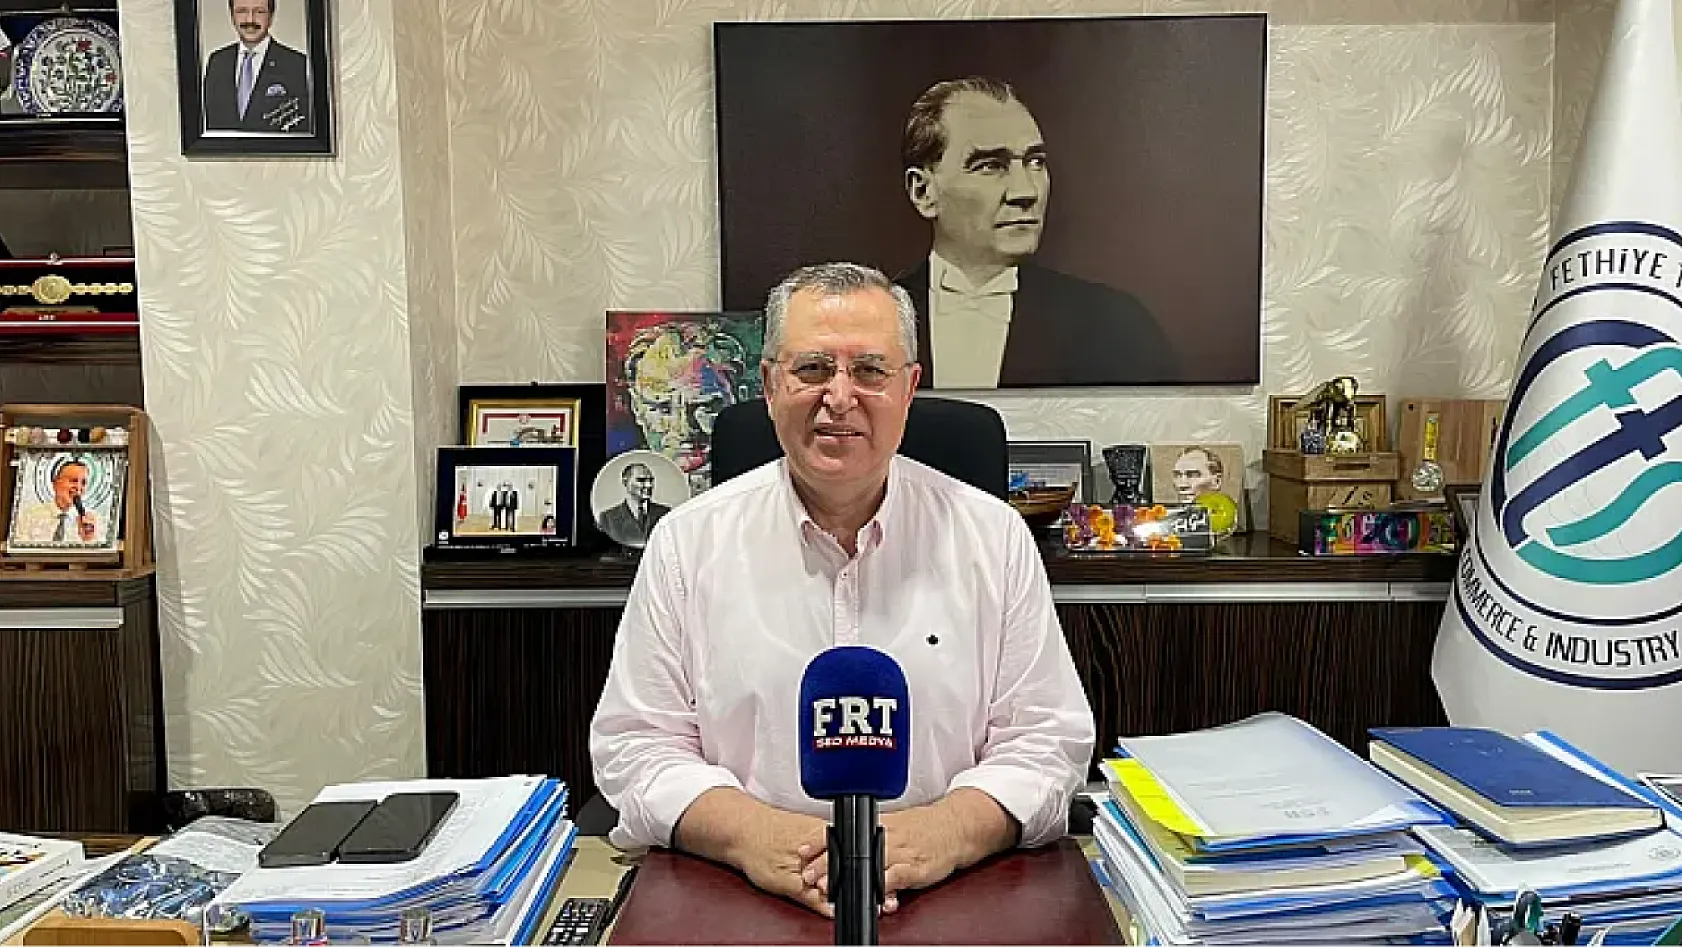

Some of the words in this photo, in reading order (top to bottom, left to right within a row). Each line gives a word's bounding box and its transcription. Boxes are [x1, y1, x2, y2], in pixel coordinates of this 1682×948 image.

[1522, 624, 1539, 652] &
[1544, 629, 1681, 667] INDUSTRY
[812, 696, 898, 737] FRT
